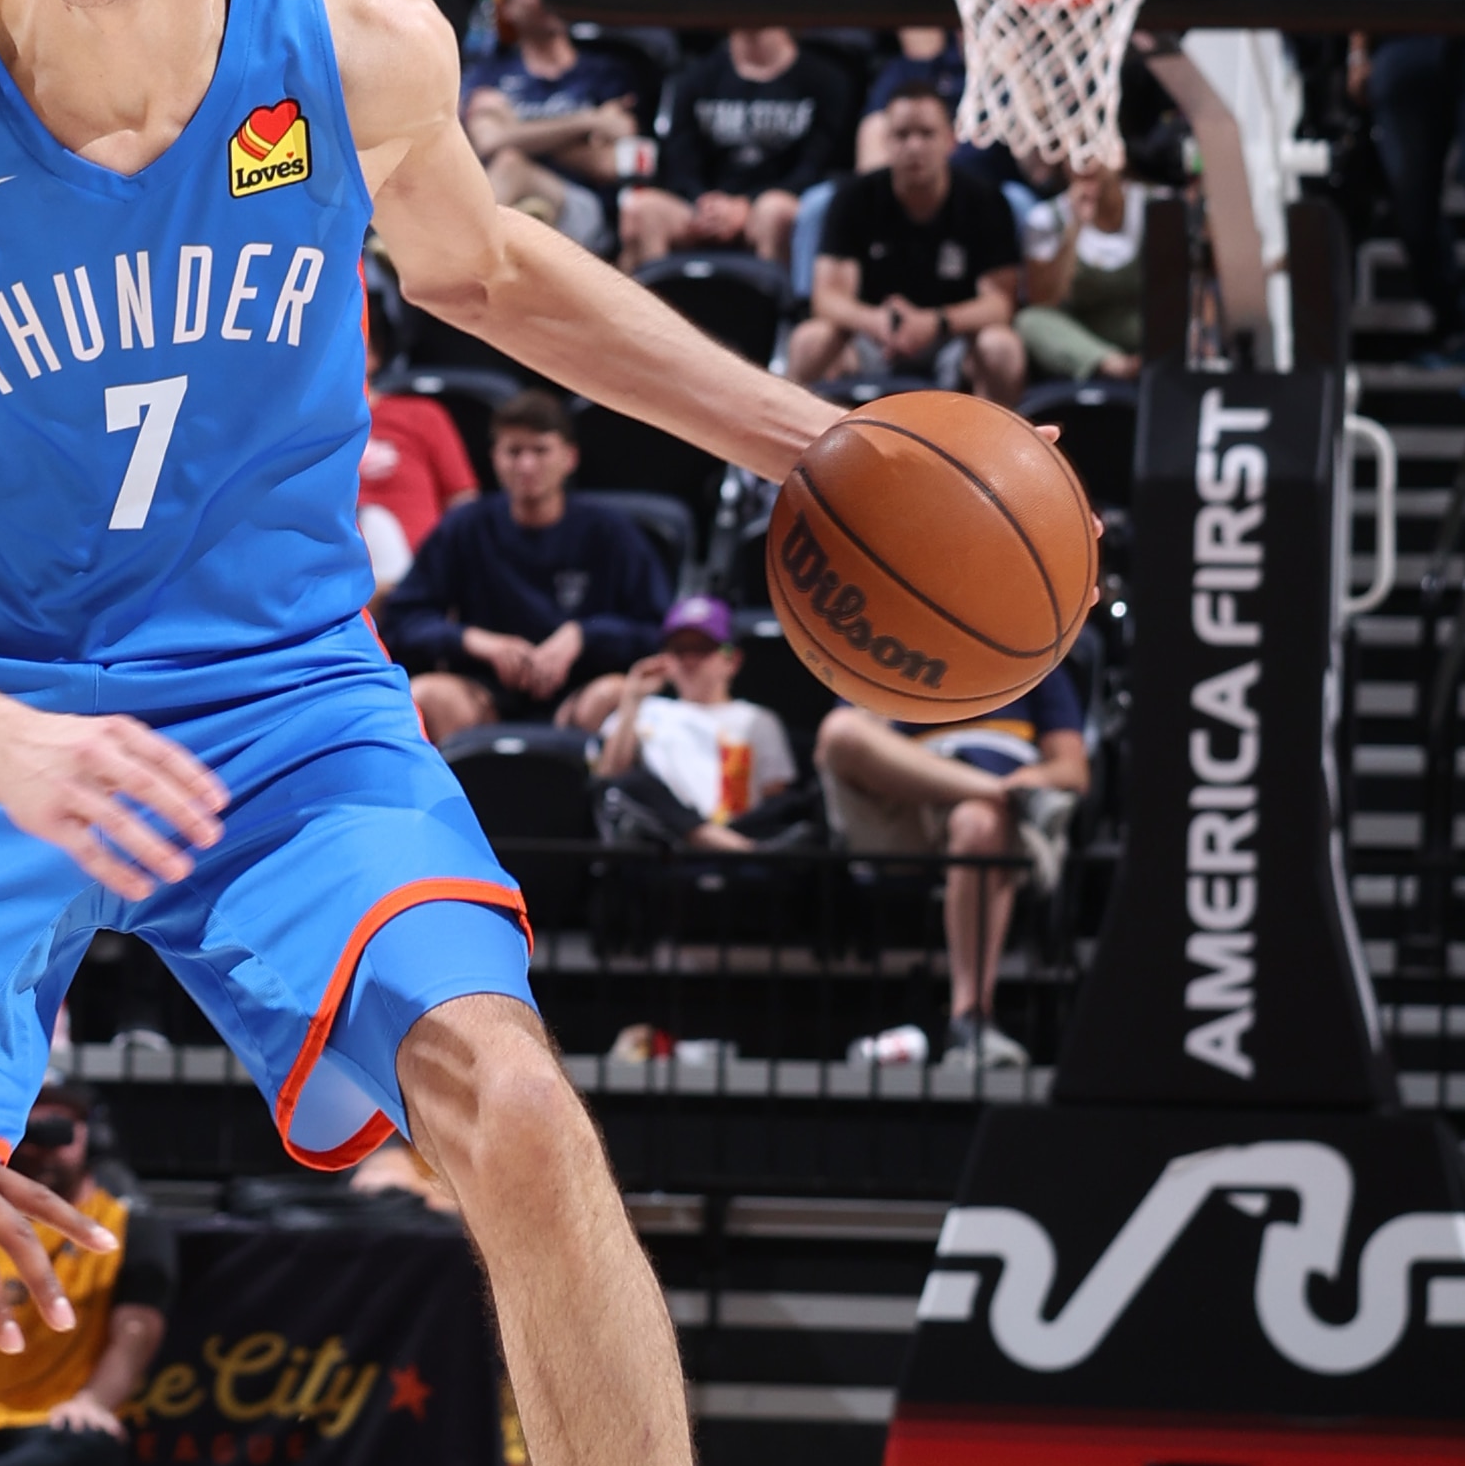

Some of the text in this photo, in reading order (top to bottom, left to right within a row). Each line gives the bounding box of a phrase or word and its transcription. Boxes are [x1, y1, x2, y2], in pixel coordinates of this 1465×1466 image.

[104, 374, 188, 530] 7
[781, 508, 948, 690] Wilson
[1183, 386, 1271, 1080] AMERICA FIRST
[204, 1332, 382, 1437] City
